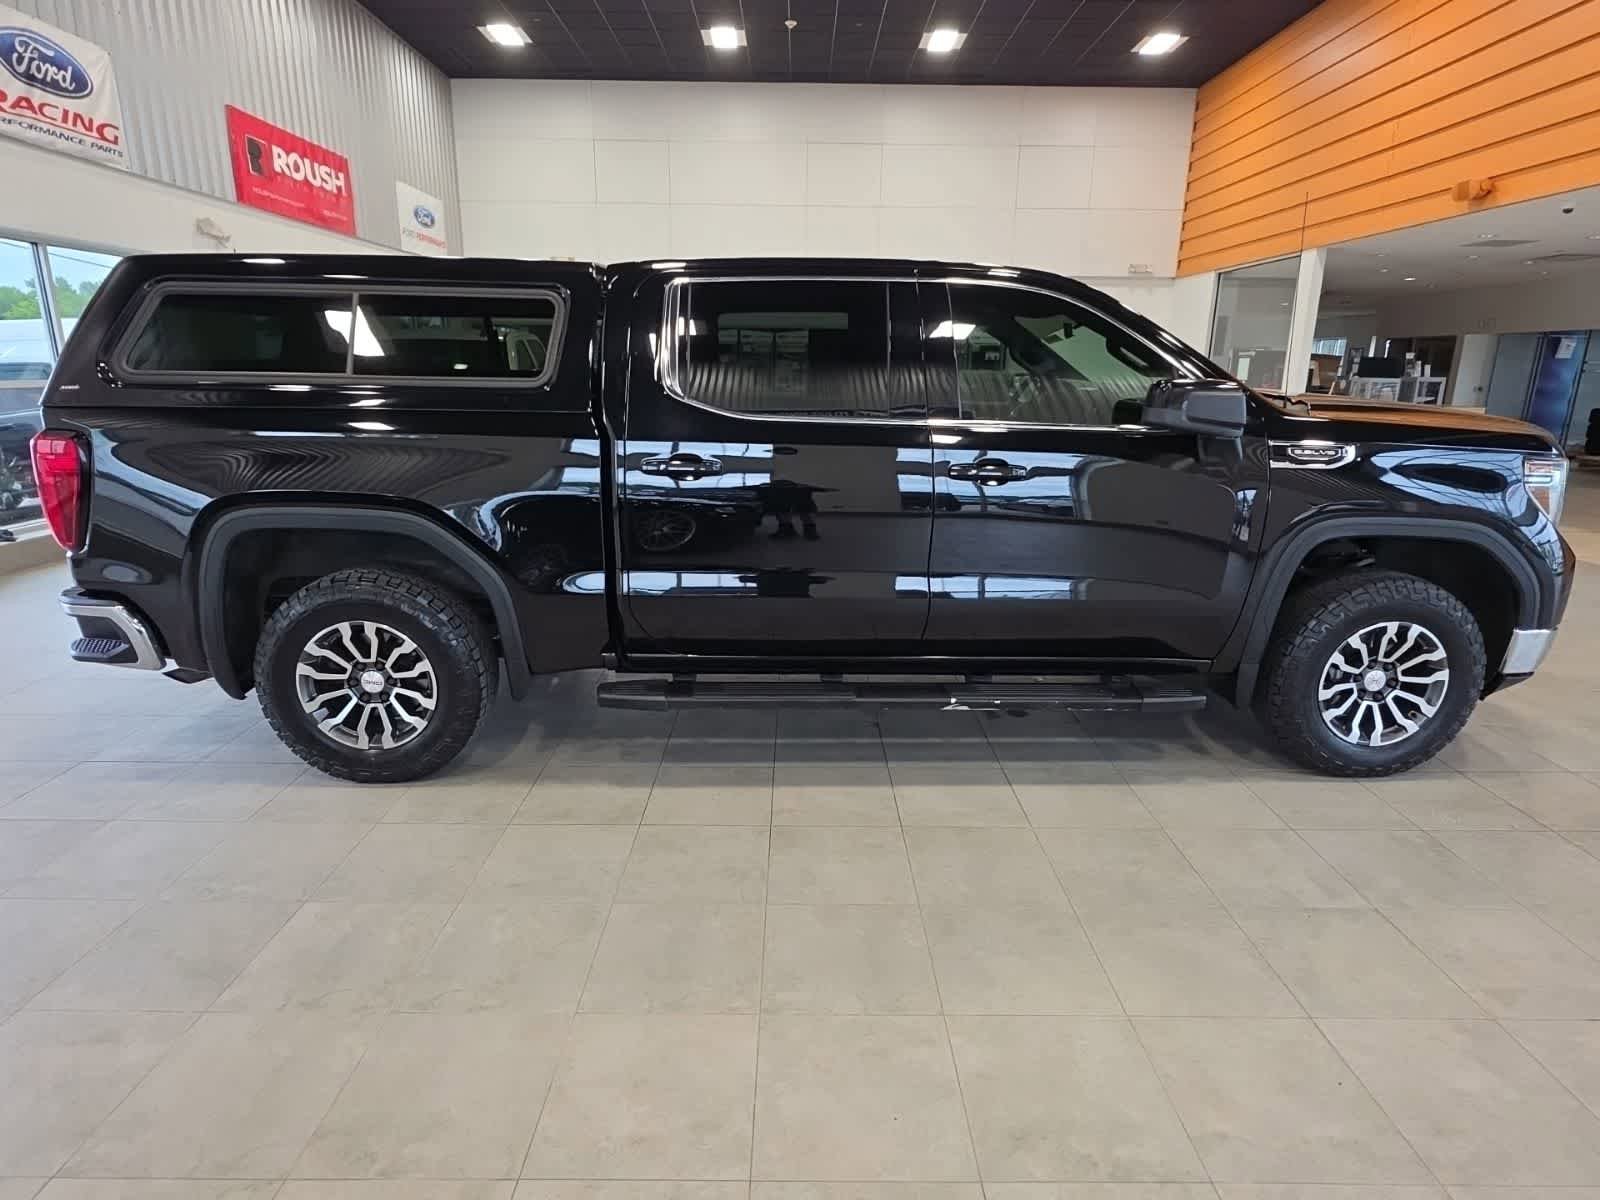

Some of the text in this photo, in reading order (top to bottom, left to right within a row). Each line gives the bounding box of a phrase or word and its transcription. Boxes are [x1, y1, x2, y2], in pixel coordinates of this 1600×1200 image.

[12, 36, 76, 90] Ford
[90, 141, 124, 159] PARTS
[271, 144, 347, 197] ROUSH
